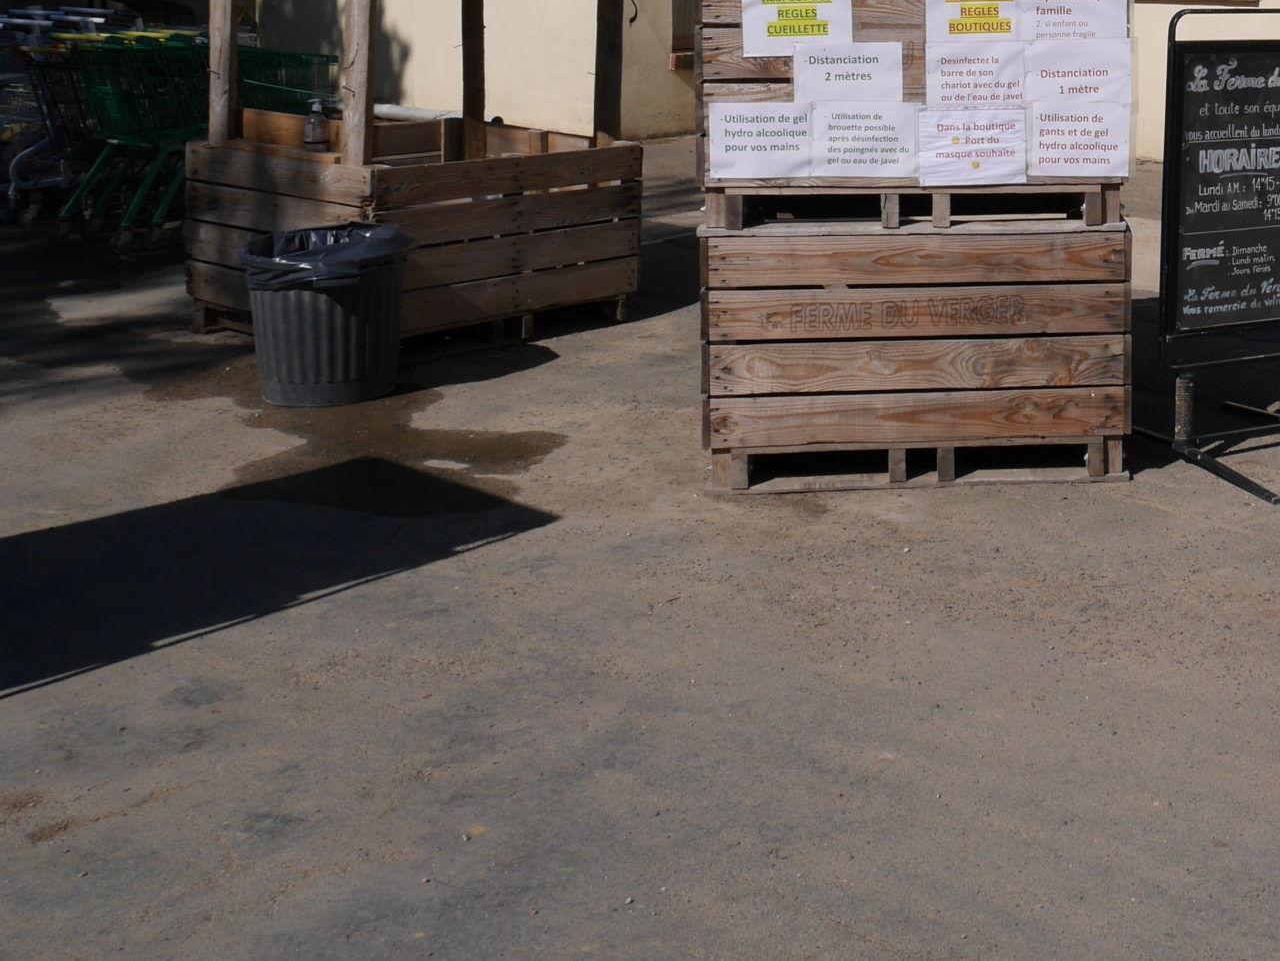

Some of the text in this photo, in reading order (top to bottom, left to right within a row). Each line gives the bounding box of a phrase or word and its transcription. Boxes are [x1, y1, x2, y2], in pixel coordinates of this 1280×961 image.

[777, 8, 817, 18] REGLES
[960, 6, 999, 16] REGLES
[1036, 6, 1072, 15] famille
[767, 24, 829, 34] CUEILLETTE
[949, 21, 1012, 32] BOUTIQUES
[1036, 31, 1096, 39] personne fragile
[991, 56, 999, 64] la
[825, 71, 872, 81] 2 mètres
[941, 69, 964, 77] barre
[1187, 65, 1209, 92] La
[1213, 58, 1265, 90] Ferme
[941, 81, 971, 89] chariot
[994, 80, 1006, 88] du
[1007, 80, 1020, 89] gel
[1059, 84, 1099, 94] 1 mètre
[1002, 92, 1023, 101] javel
[1199, 103, 1210, 116] et
[1215, 102, 1240, 115] toute
[1244, 104, 1260, 113] son
[778, 114, 791, 123] de
[793, 114, 808, 124] gel
[1091, 114, 1103, 123] de
[864, 124, 896, 132] possible
[937, 123, 960, 131] Dans
[973, 122, 1016, 131] boutique
[1204, 123, 1248, 139] accueillent
[1250, 126, 1260, 137] du
[1263, 123, 1280, 136] lundi
[724, 128, 807, 139] hydro alcoolique
[1039, 128, 1109, 138] gants et de gel
[827, 135, 850, 143] après
[965, 136, 984, 144] Port
[725, 144, 748, 153] pour
[770, 143, 800, 151] mains
[1039, 141, 1119, 152] hydro alcoolique
[935, 151, 973, 159] masque
[827, 157, 840, 165] gel
[880, 157, 899, 165] javel
[1039, 156, 1061, 165] pour
[1082, 156, 1111, 164] mains
[1198, 183, 1223, 196] Lundi
[1194, 200, 1220, 213] Mardi
[1221, 203, 1230, 211] au
[1232, 243, 1268, 256] Dimanche
[1232, 257, 1251, 265] Lundi
[1231, 267, 1250, 276] Jours
[1201, 285, 1237, 301] Ferme
[1240, 283, 1257, 297] du
[1204, 301, 1247, 313] remercie
[1250, 299, 1262, 309] de
[790, 295, 1025, 334] FERME DU VERGER
